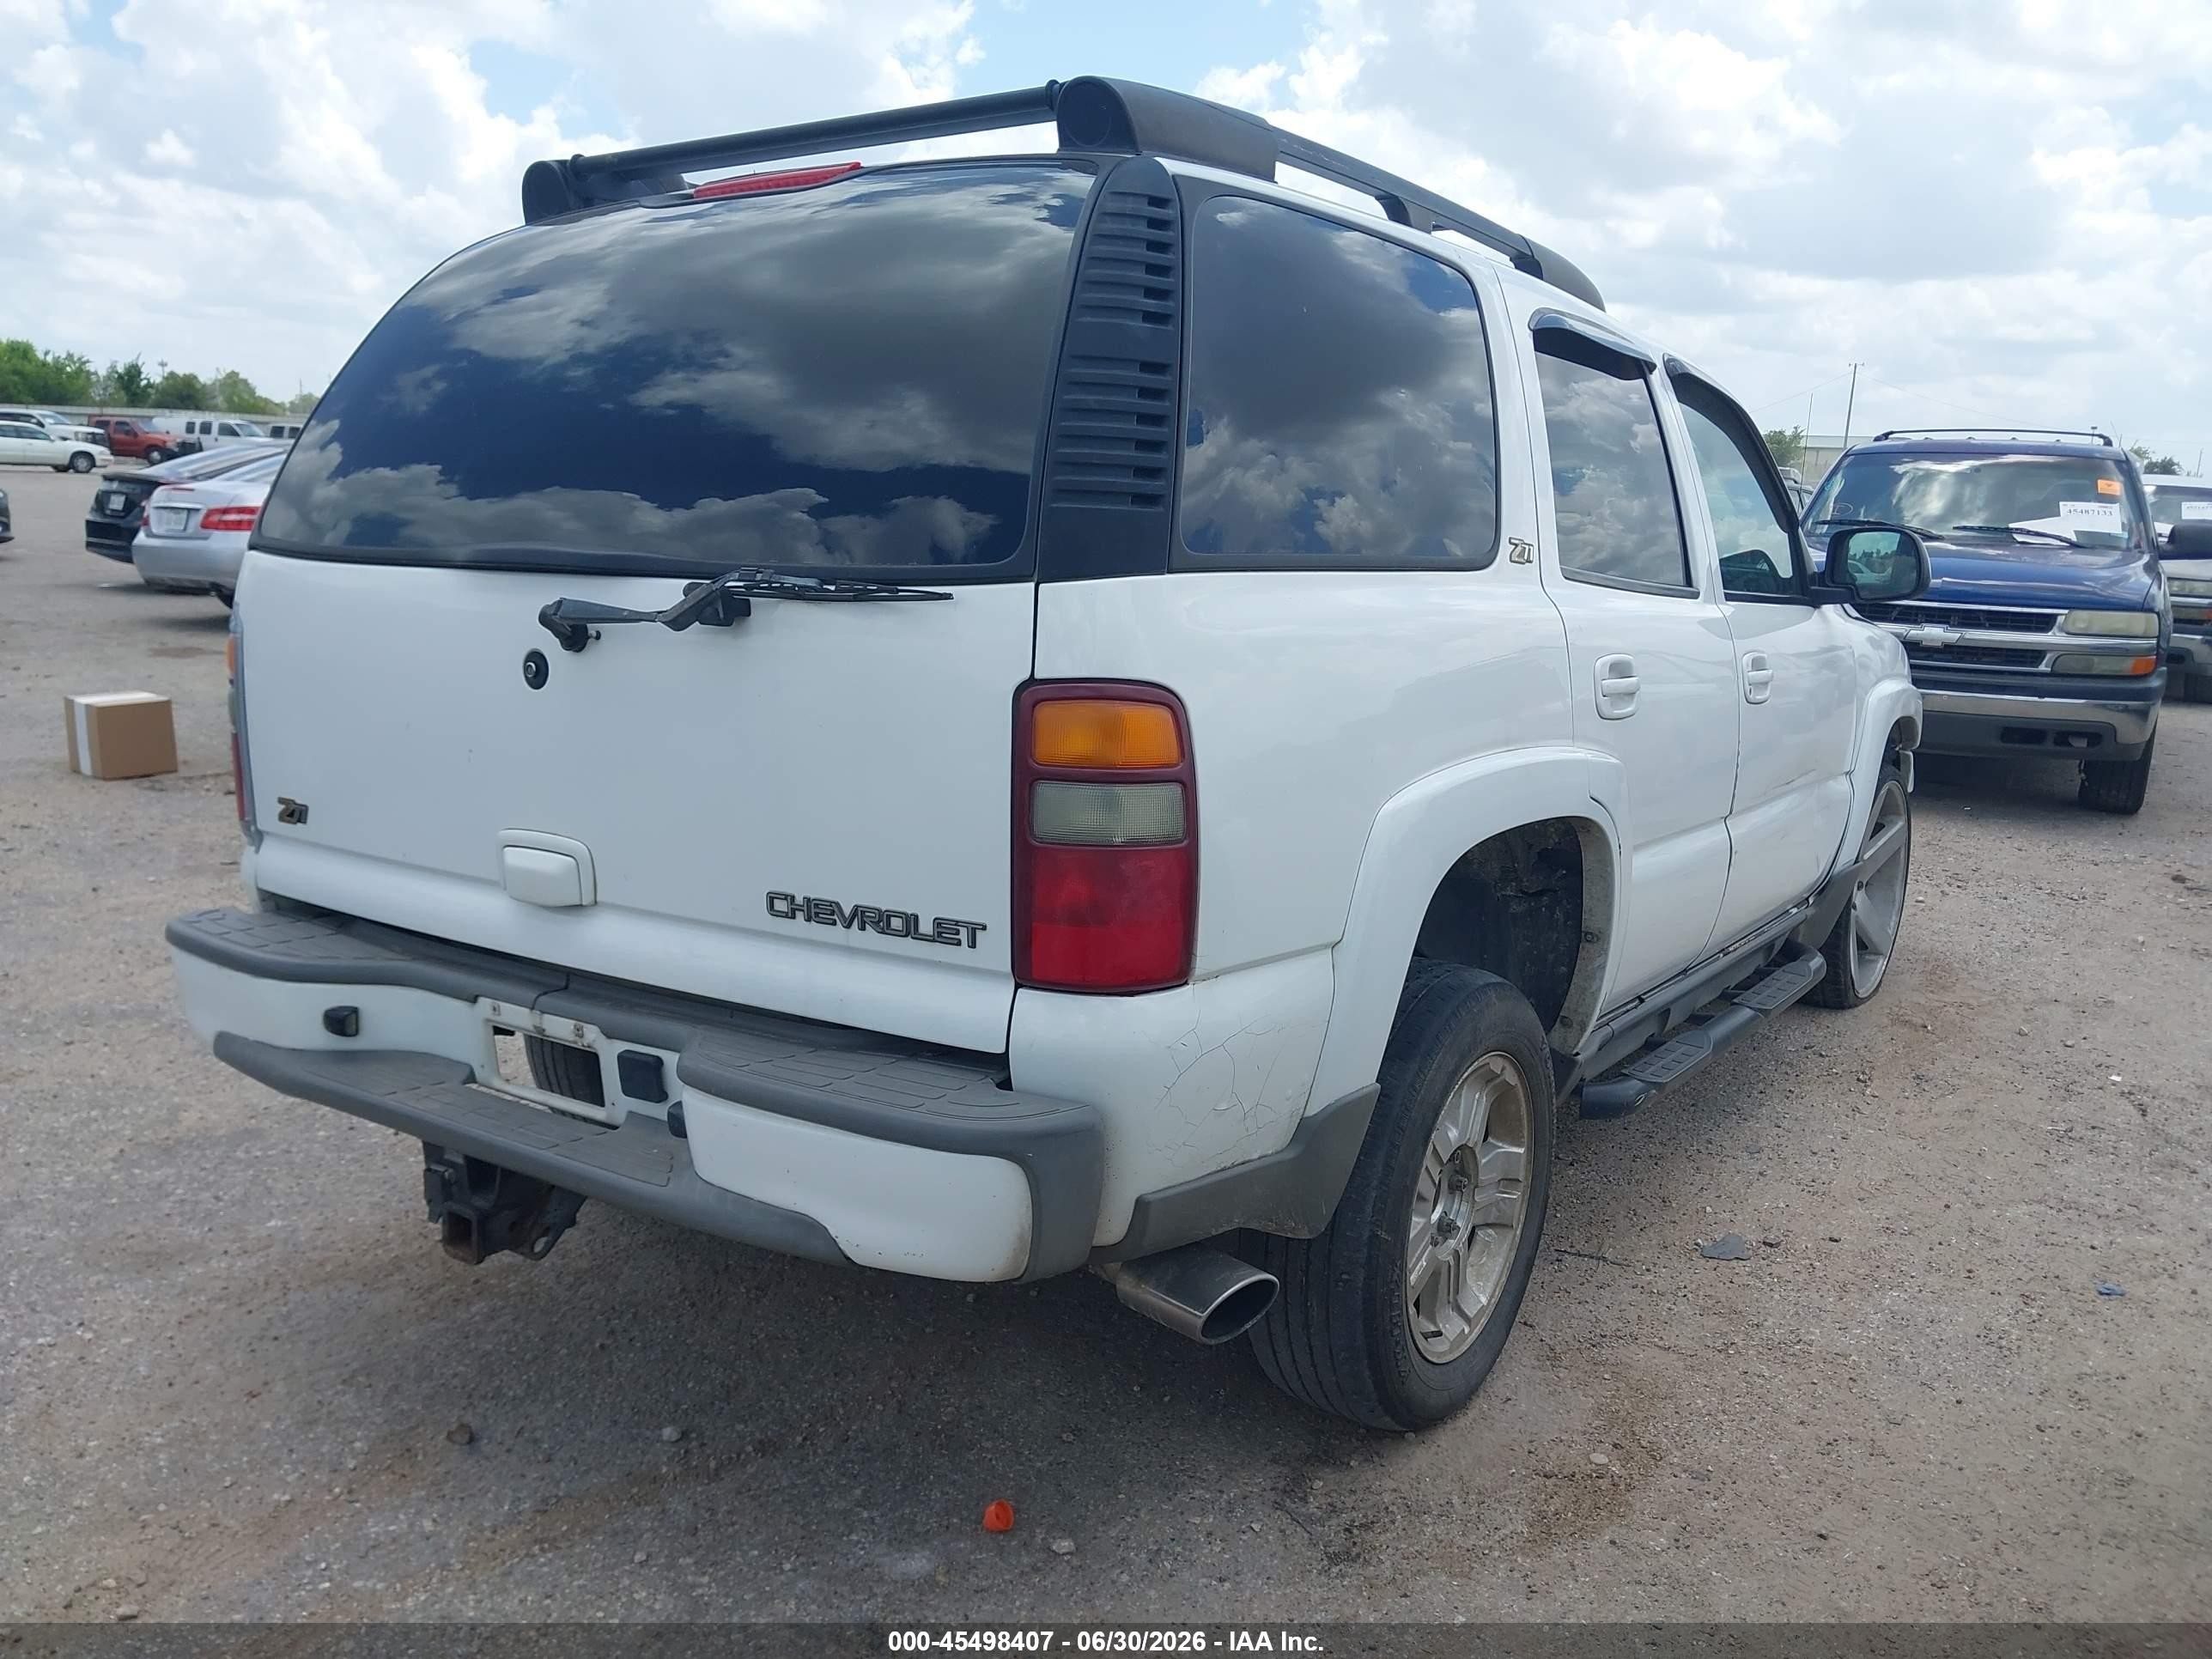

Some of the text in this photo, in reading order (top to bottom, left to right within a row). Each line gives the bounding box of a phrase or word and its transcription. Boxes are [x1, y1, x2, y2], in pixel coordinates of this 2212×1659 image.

[1509, 537, 1534, 565] Z71
[277, 796, 309, 825] Z71
[766, 890, 987, 949] CHEVROLET
